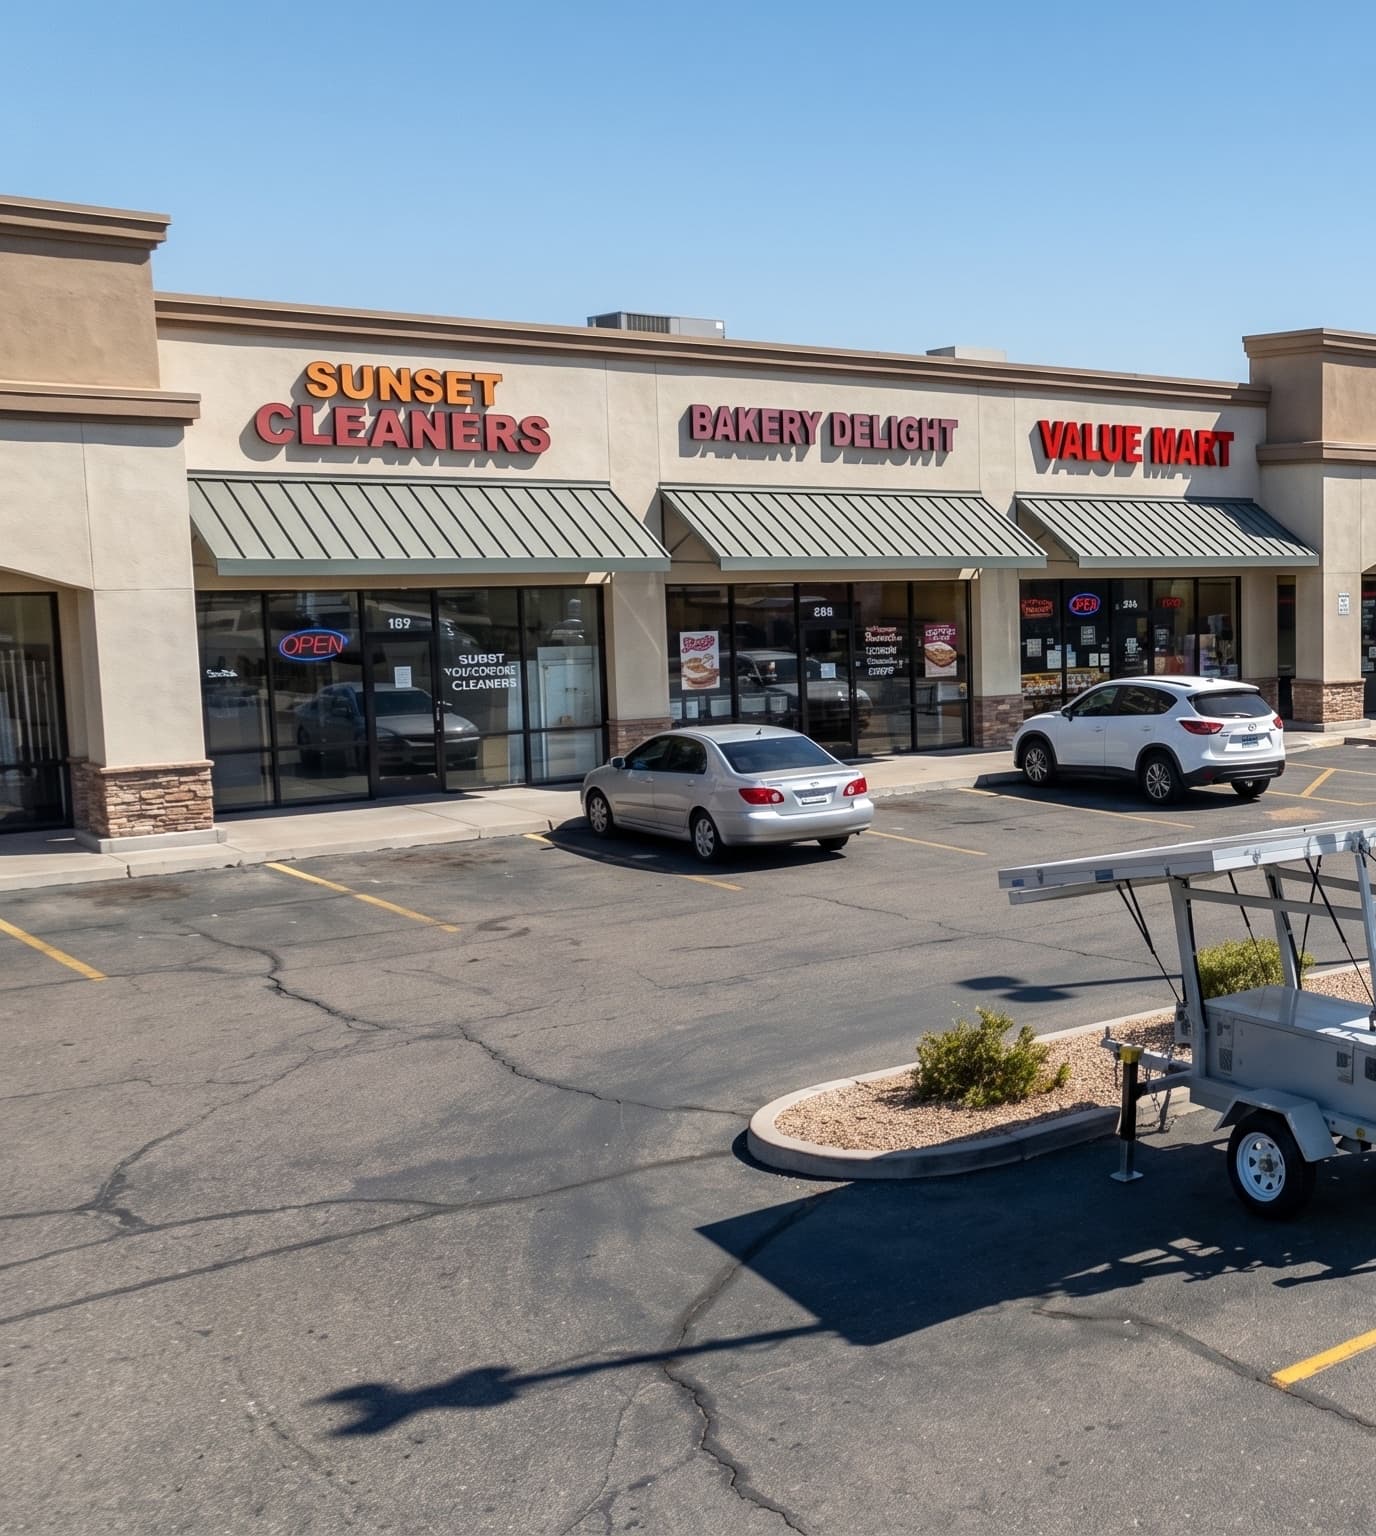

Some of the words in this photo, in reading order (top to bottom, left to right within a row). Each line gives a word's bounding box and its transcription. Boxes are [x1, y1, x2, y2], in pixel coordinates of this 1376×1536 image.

[305, 361, 502, 406] SUNSET
[254, 402, 551, 454] CLEANERS
[690, 404, 822, 445] BAKERY
[830, 412, 959, 452] DELIGHT
[1037, 420, 1142, 463] VALUE
[1150, 427, 1234, 467] MART
[282, 635, 344, 655] OPEN
[451, 678, 517, 691] CLEANERS
